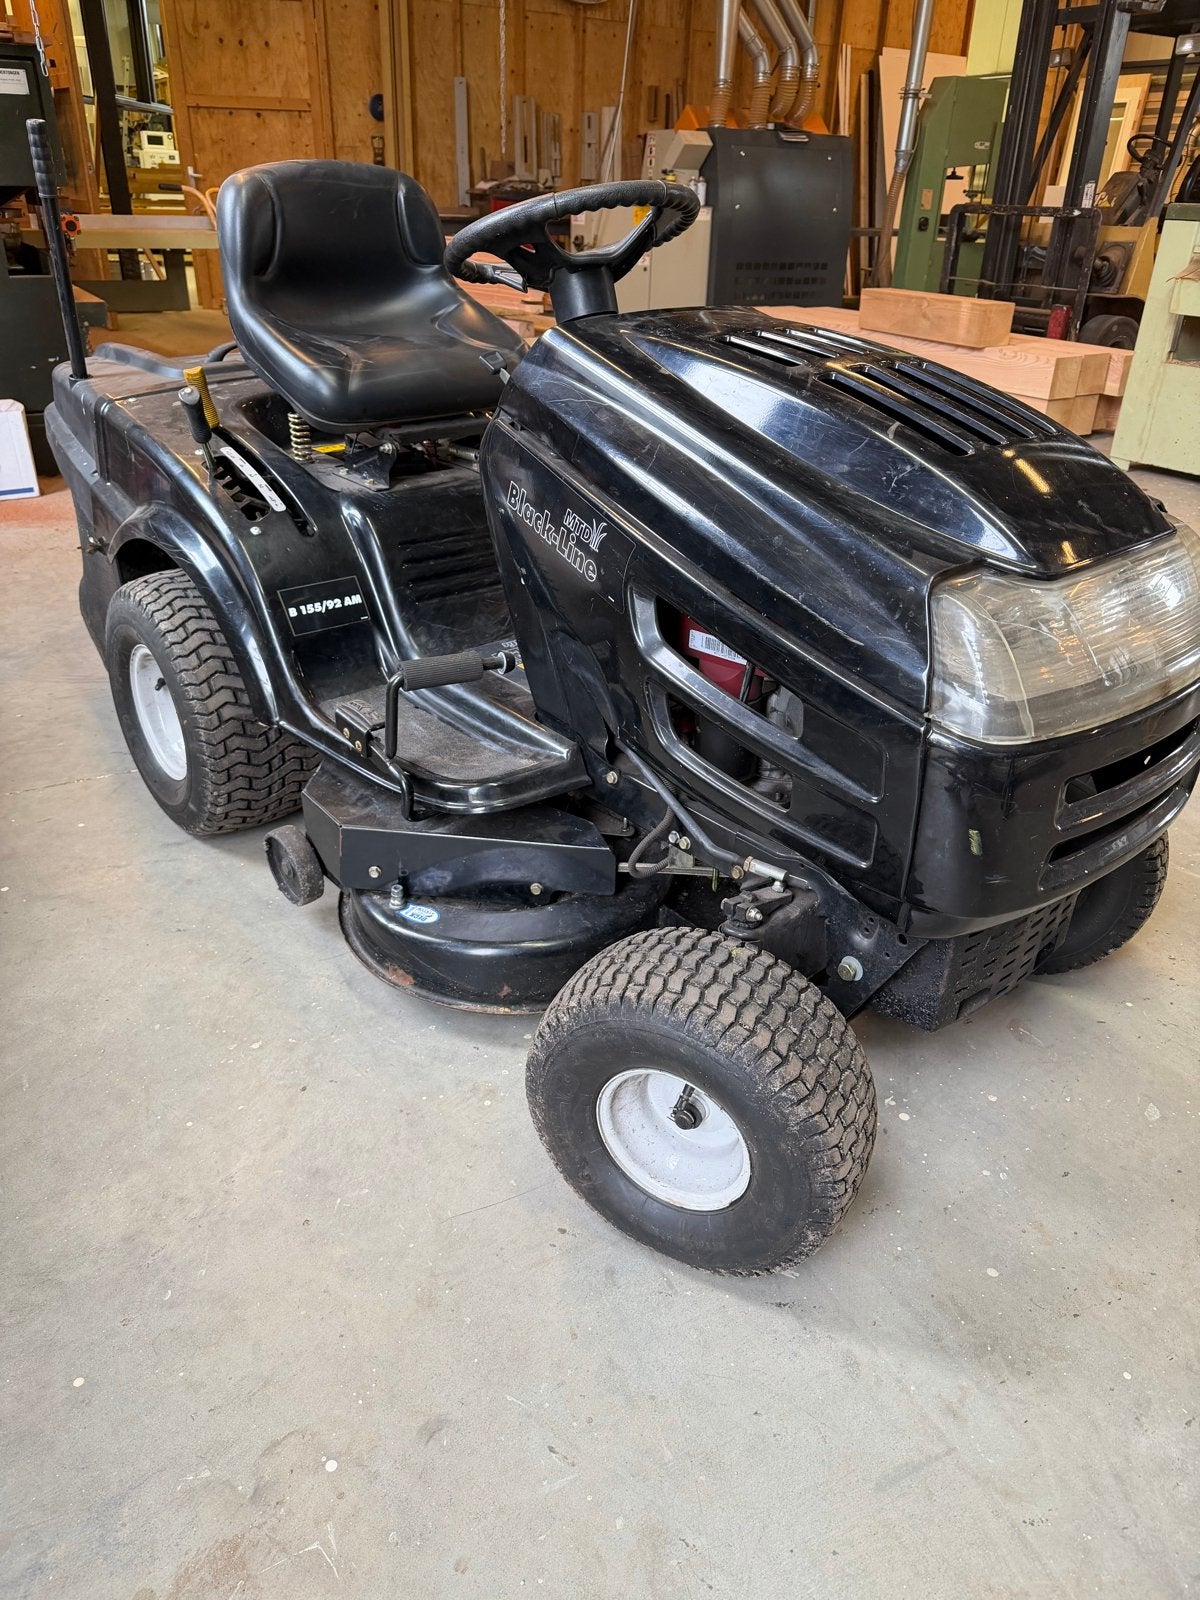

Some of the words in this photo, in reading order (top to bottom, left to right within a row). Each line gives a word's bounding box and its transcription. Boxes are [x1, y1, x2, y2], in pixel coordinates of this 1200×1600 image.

[506, 480, 598, 582] Black-Line
[563, 508, 594, 543] MTD
[288, 607, 298, 618] B
[299, 598, 342, 615] 155/92
[343, 594, 363, 606] AM
